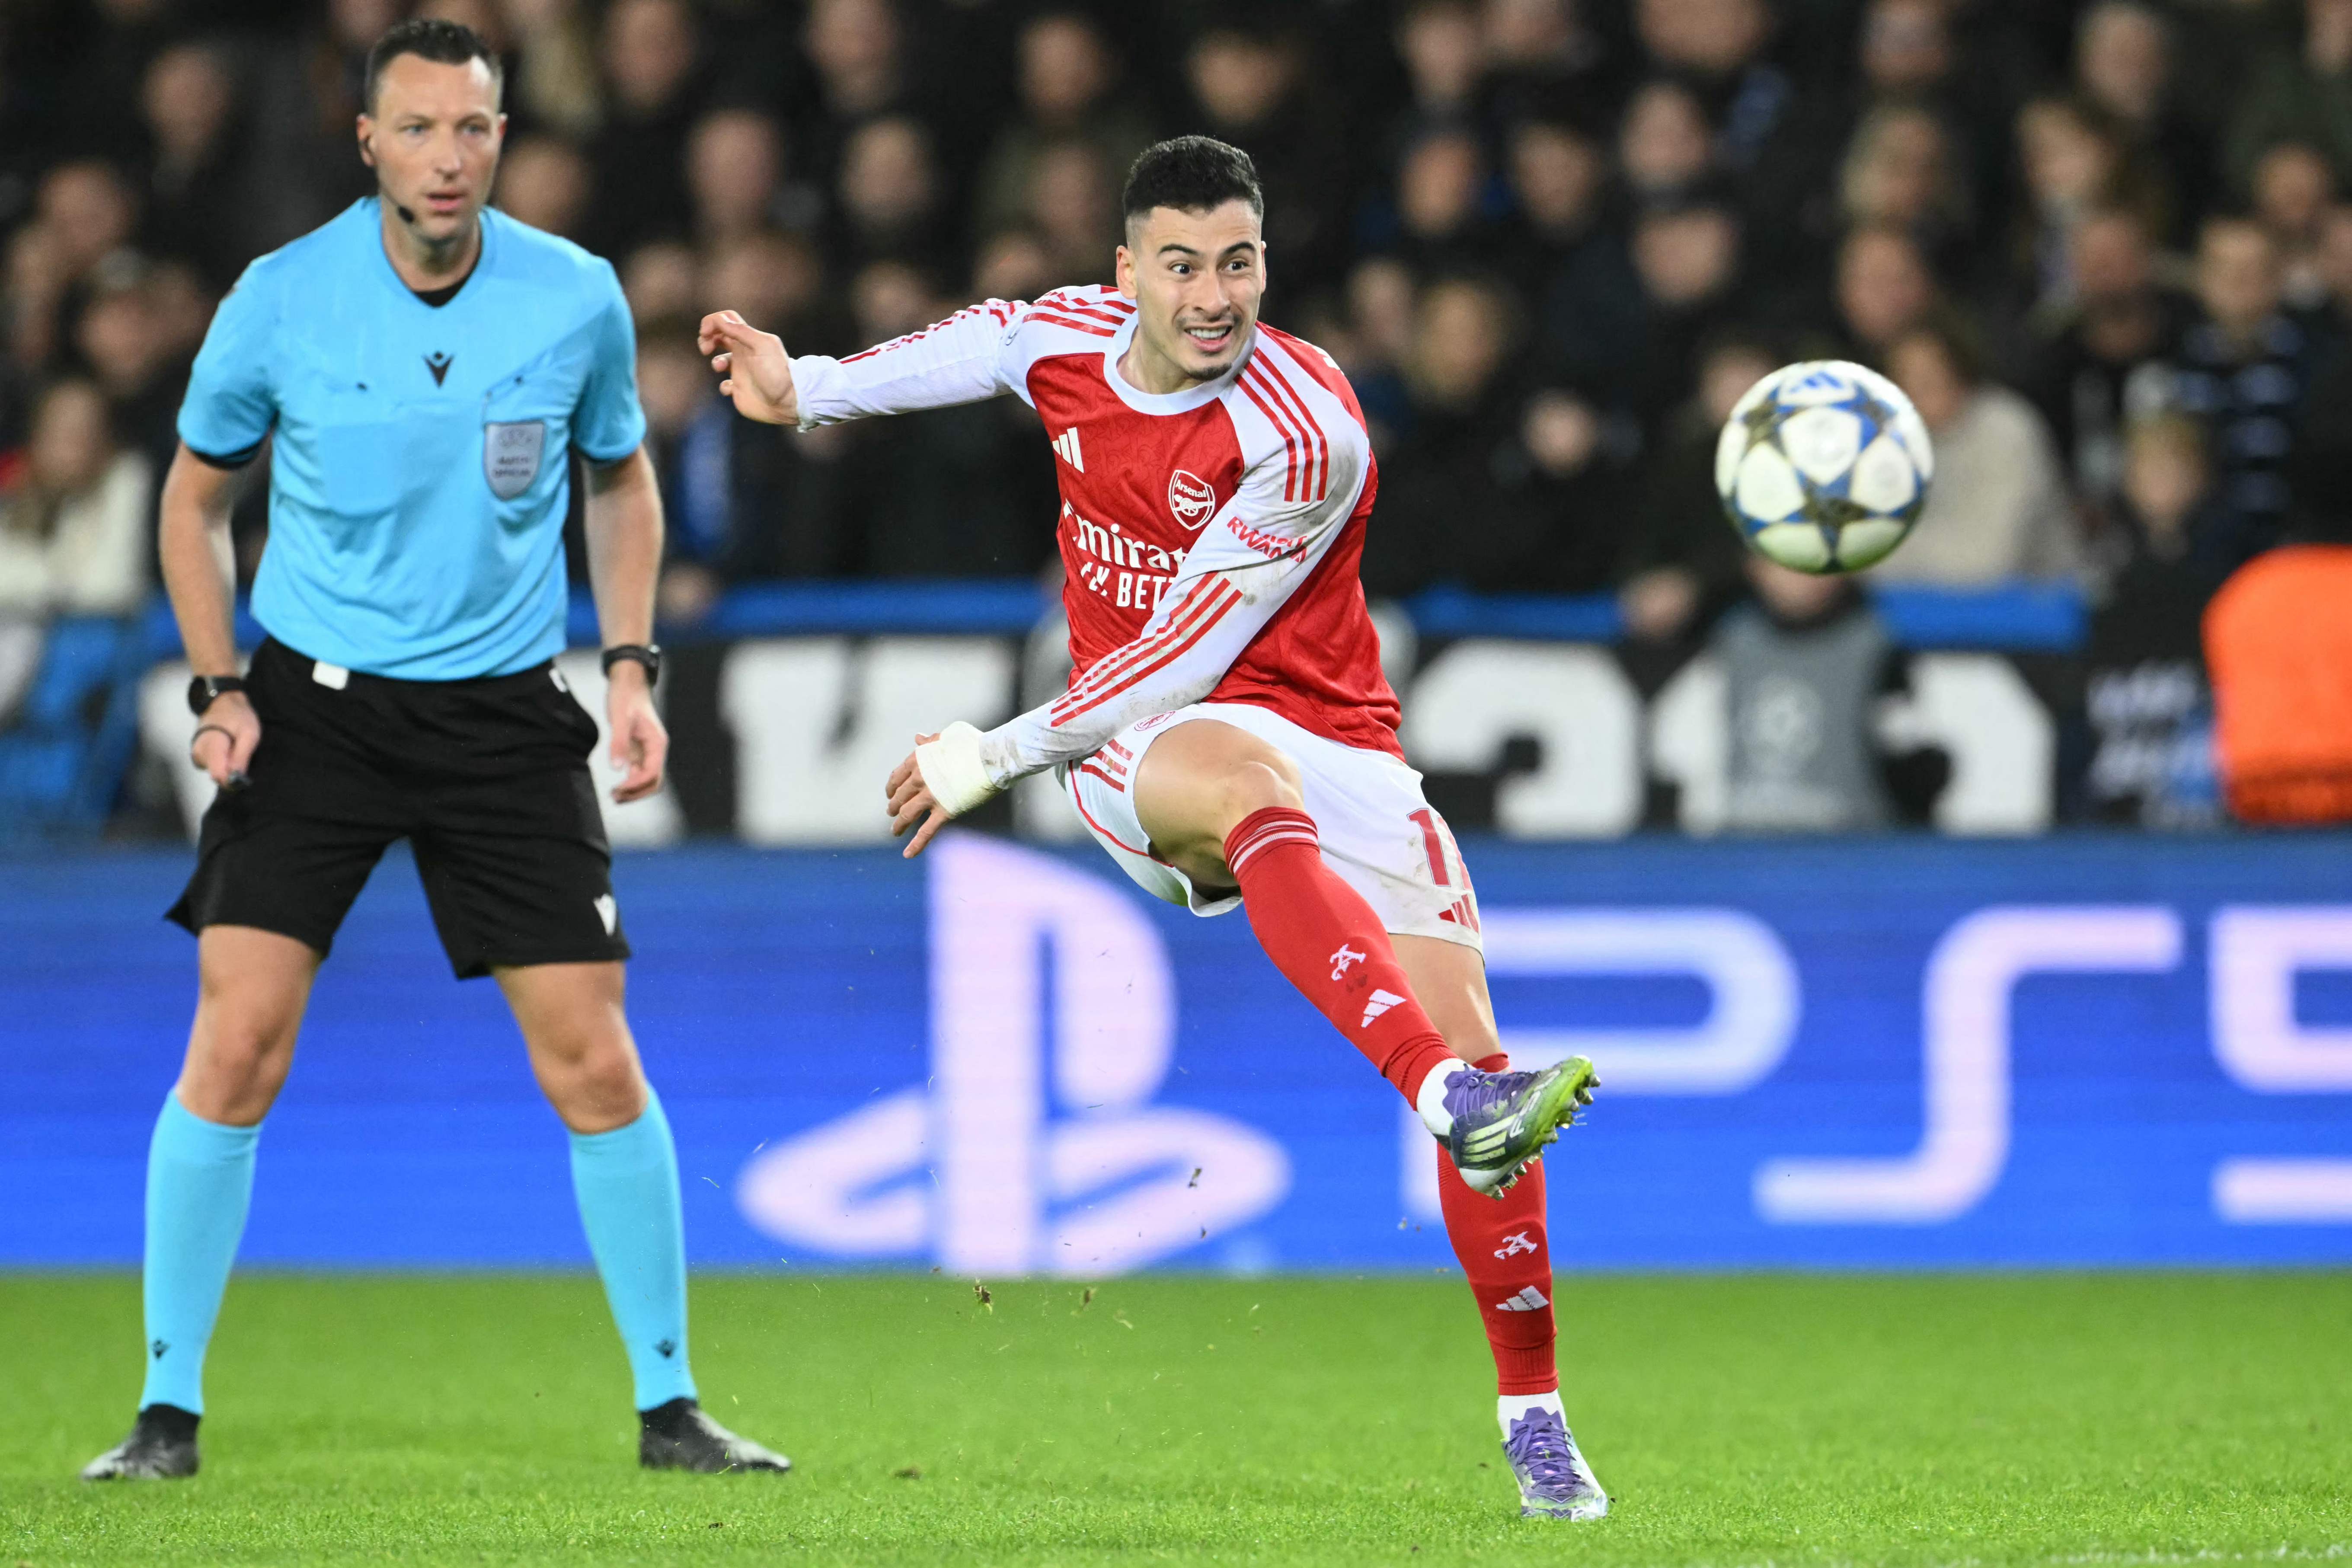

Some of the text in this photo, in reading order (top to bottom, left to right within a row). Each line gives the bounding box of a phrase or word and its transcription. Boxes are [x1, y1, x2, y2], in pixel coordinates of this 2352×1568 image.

[1175, 479, 1207, 498] Arsenal
[1063, 498, 1189, 573] mirat
[1116, 572, 1176, 611] BET
